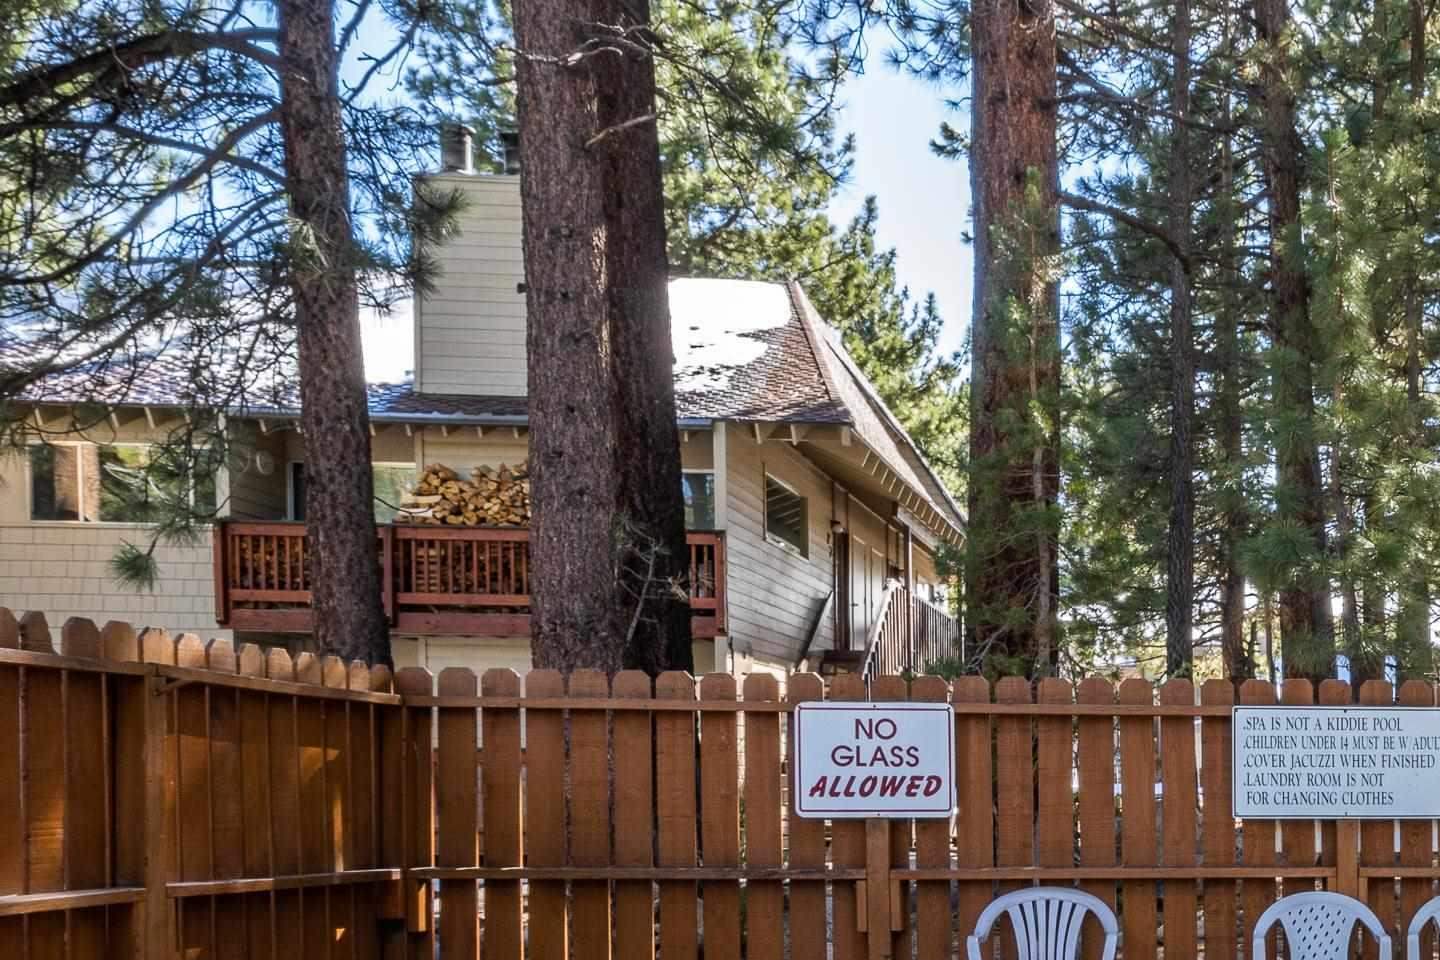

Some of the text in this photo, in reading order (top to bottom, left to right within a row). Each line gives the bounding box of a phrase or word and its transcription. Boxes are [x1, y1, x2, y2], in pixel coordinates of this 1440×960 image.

[855, 718, 897, 740] NO
[1271, 717, 1280, 731] IS
[1286, 717, 1311, 731] NOT
[1315, 717, 1322, 731] A
[1327, 717, 1368, 731] KIDDIE
[1373, 717, 1403, 731] POOL
[1301, 736, 1336, 750] UNDER
[1340, 737, 1349, 750] 14
[1352, 736, 1380, 750] MUST
[1383, 736, 1395, 750] BE
[831, 745, 920, 767] GLASS
[1290, 754, 1335, 770] JACUZZI
[1340, 754, 1376, 769] WHEN
[1381, 754, 1435, 769] FINISHED
[809, 775, 943, 798] ALLOWED
[1307, 773, 1341, 787] ROOM
[1346, 773, 1356, 787] IS
[1361, 773, 1384, 787] NOT
[1247, 791, 1393, 805] FOR CHANGING CLOTHES
